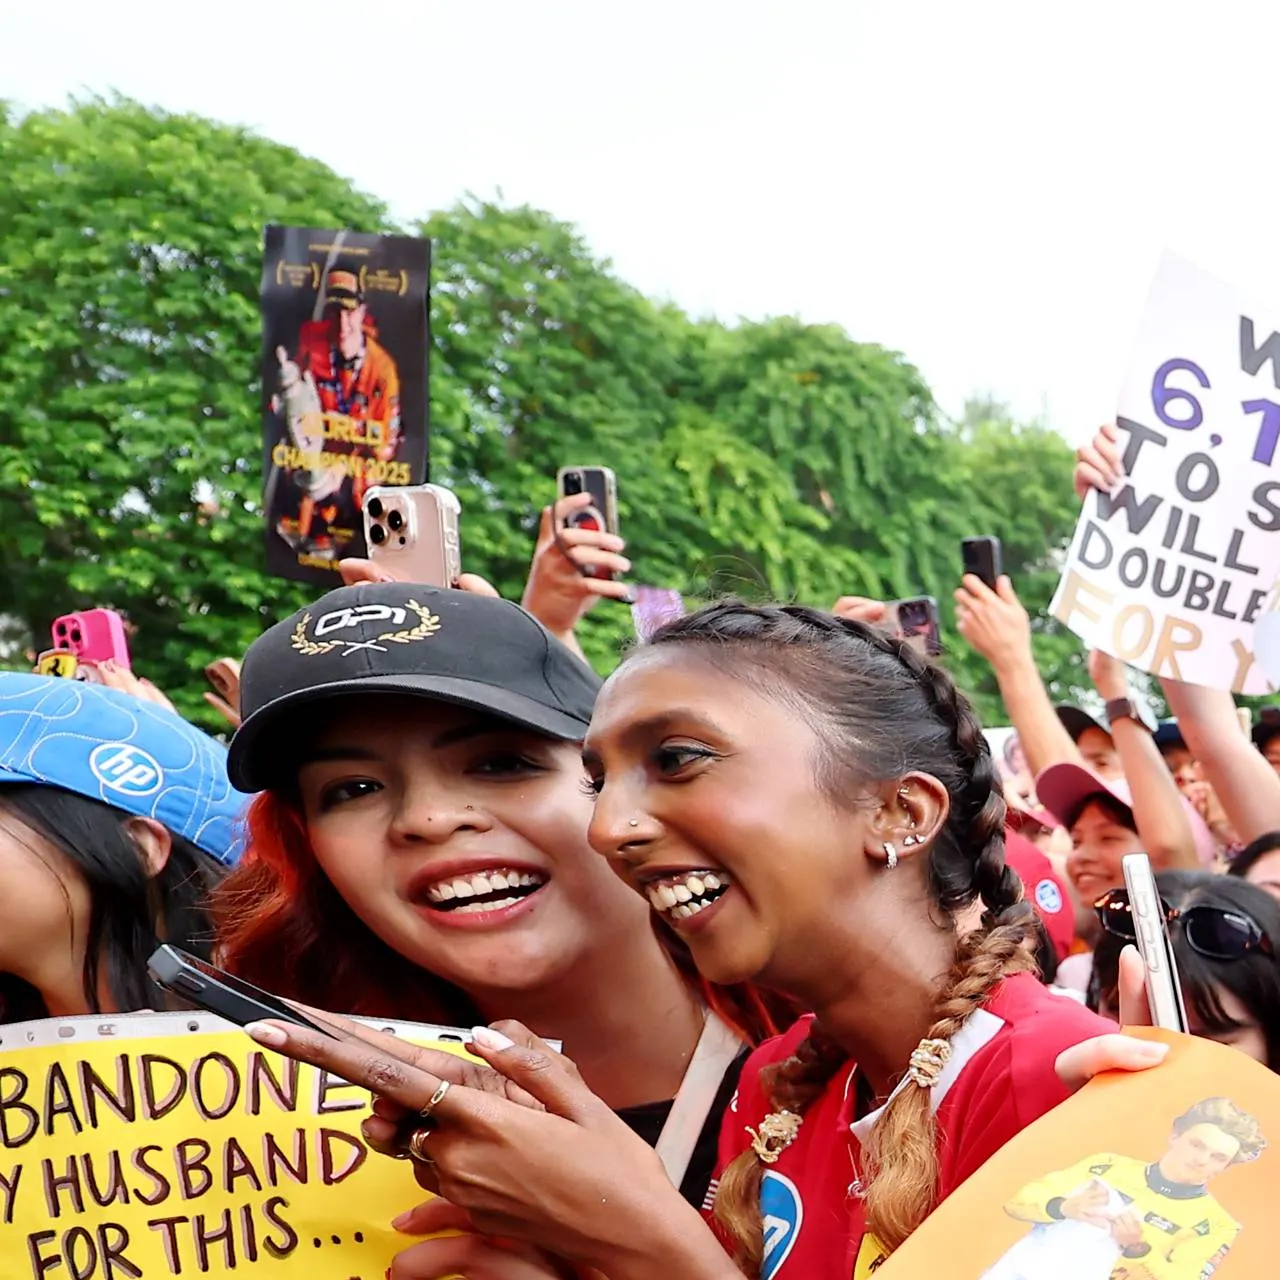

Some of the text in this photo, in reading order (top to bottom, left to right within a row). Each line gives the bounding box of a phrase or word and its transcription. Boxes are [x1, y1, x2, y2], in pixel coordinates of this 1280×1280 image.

[365, 458, 411, 486] 2025
[1116, 415, 1220, 503] TO
[1077, 520, 1268, 625] DOUBLE
[1098, 484, 1260, 576] WILL
[1055, 568, 1203, 683] FOR
[99, 747, 157, 788] hp
[41, 1127, 368, 1219] HUSBAND
